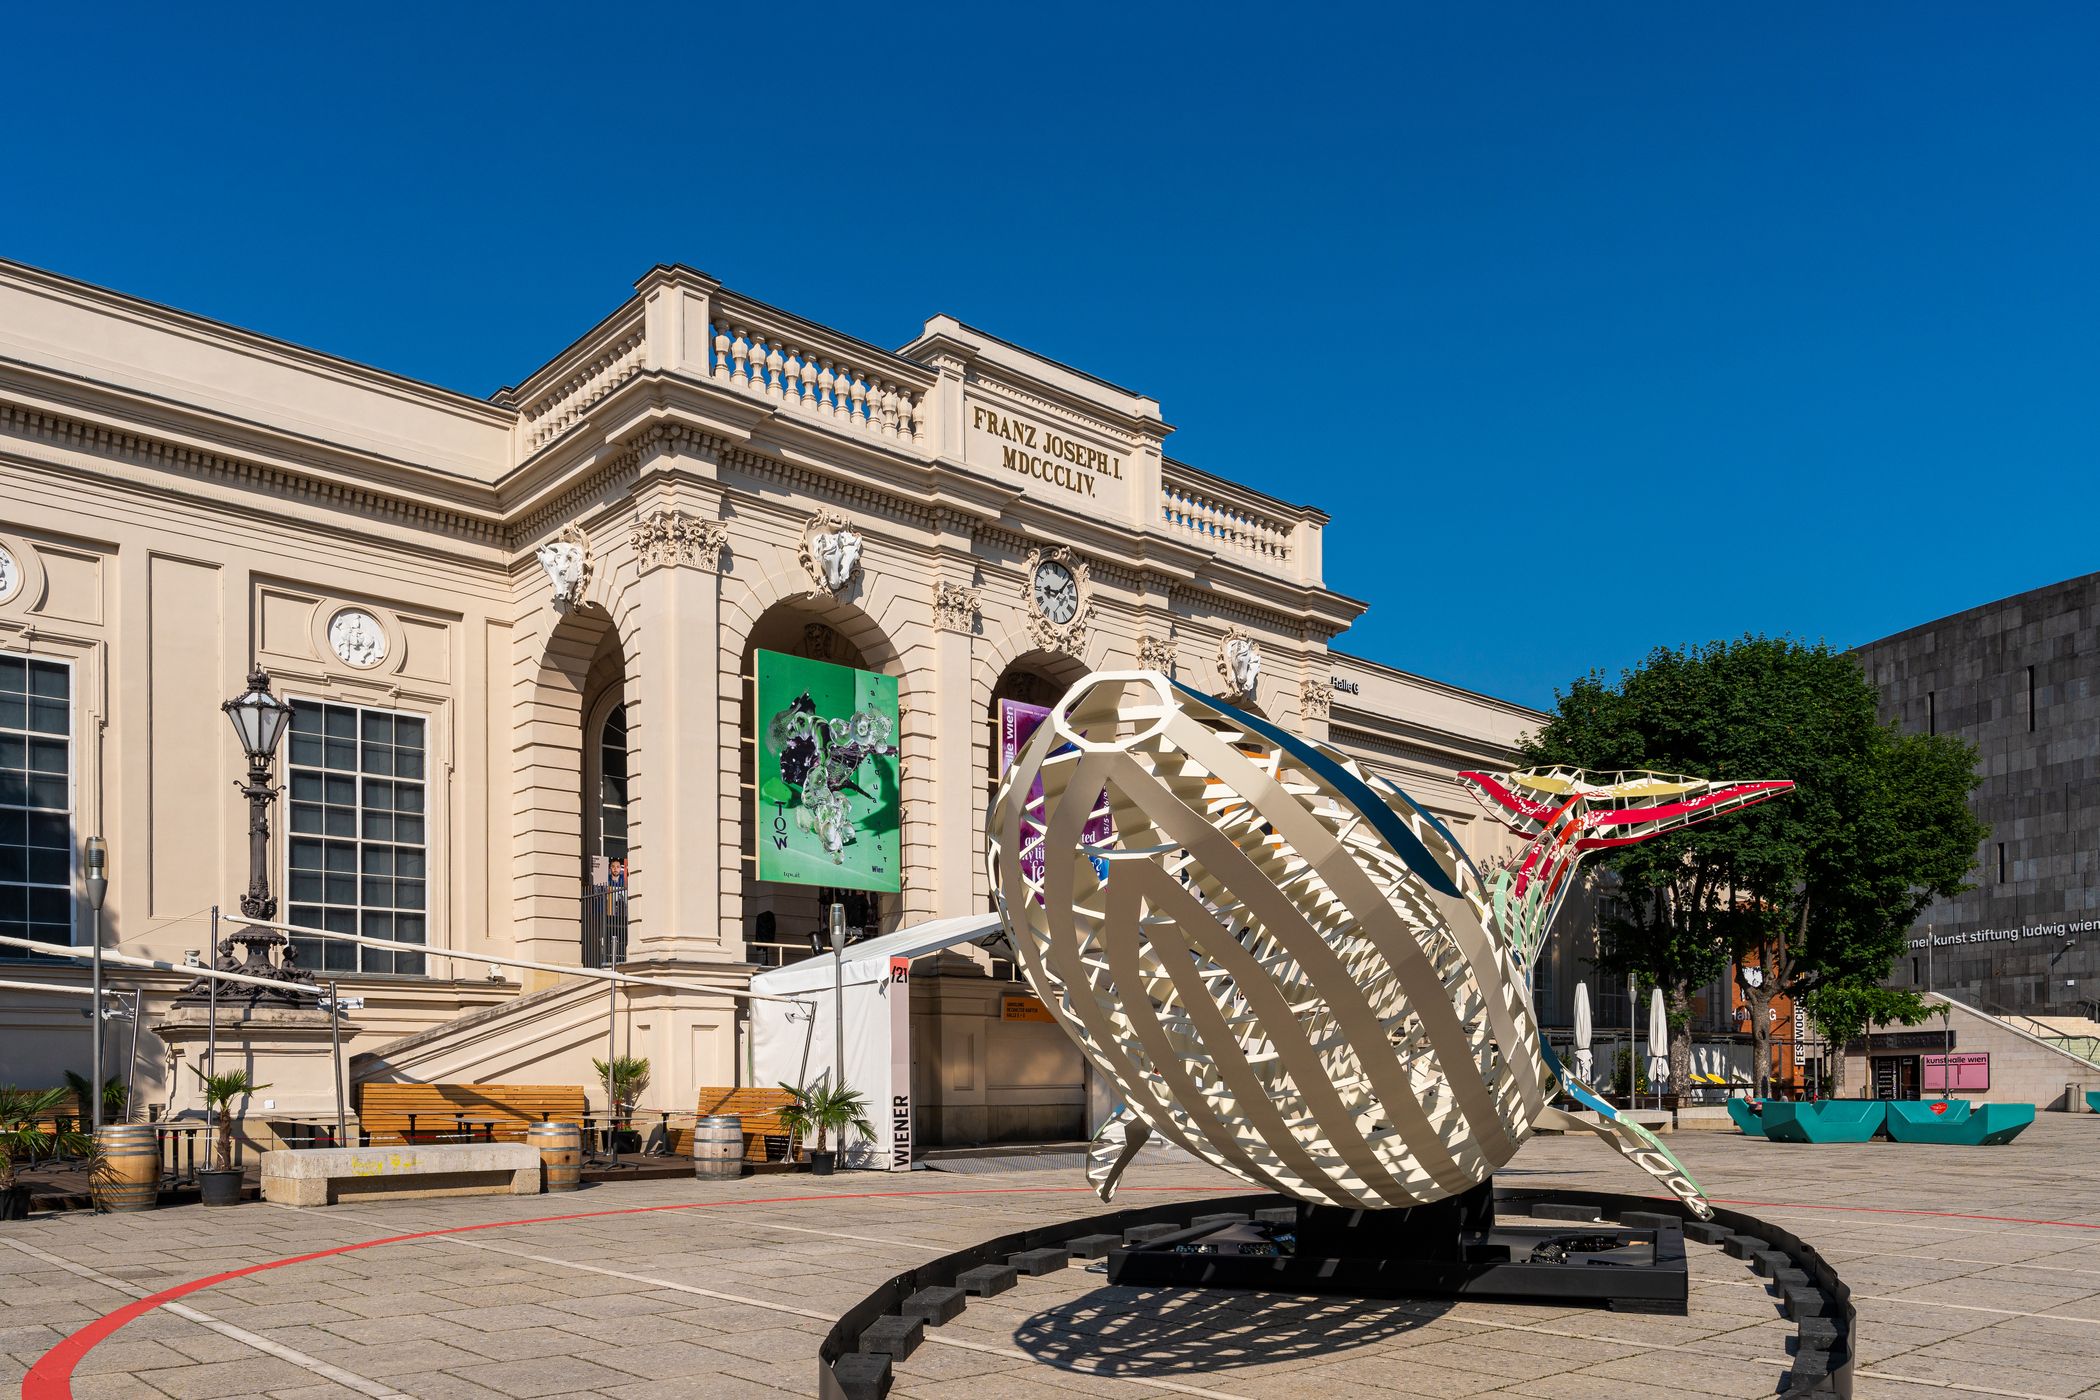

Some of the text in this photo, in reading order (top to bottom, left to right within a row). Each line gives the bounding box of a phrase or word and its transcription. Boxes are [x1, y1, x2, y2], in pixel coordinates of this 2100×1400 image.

[973, 405, 1037, 449] FRANZ
[1002, 445, 1096, 498] MDCCCLIV.
[1331, 677, 1353, 692] Halle
[1006, 706, 1014, 739] wien
[773, 801, 788, 850] TQW
[1934, 932, 1967, 946] kunst
[1969, 927, 2019, 943] stiftung
[2022, 922, 2065, 938] ludwig
[2069, 918, 2100, 932] wien
[890, 966, 908, 984] /21
[1769, 1008, 1777, 1020] G
[893, 1095, 909, 1168] WIENER
